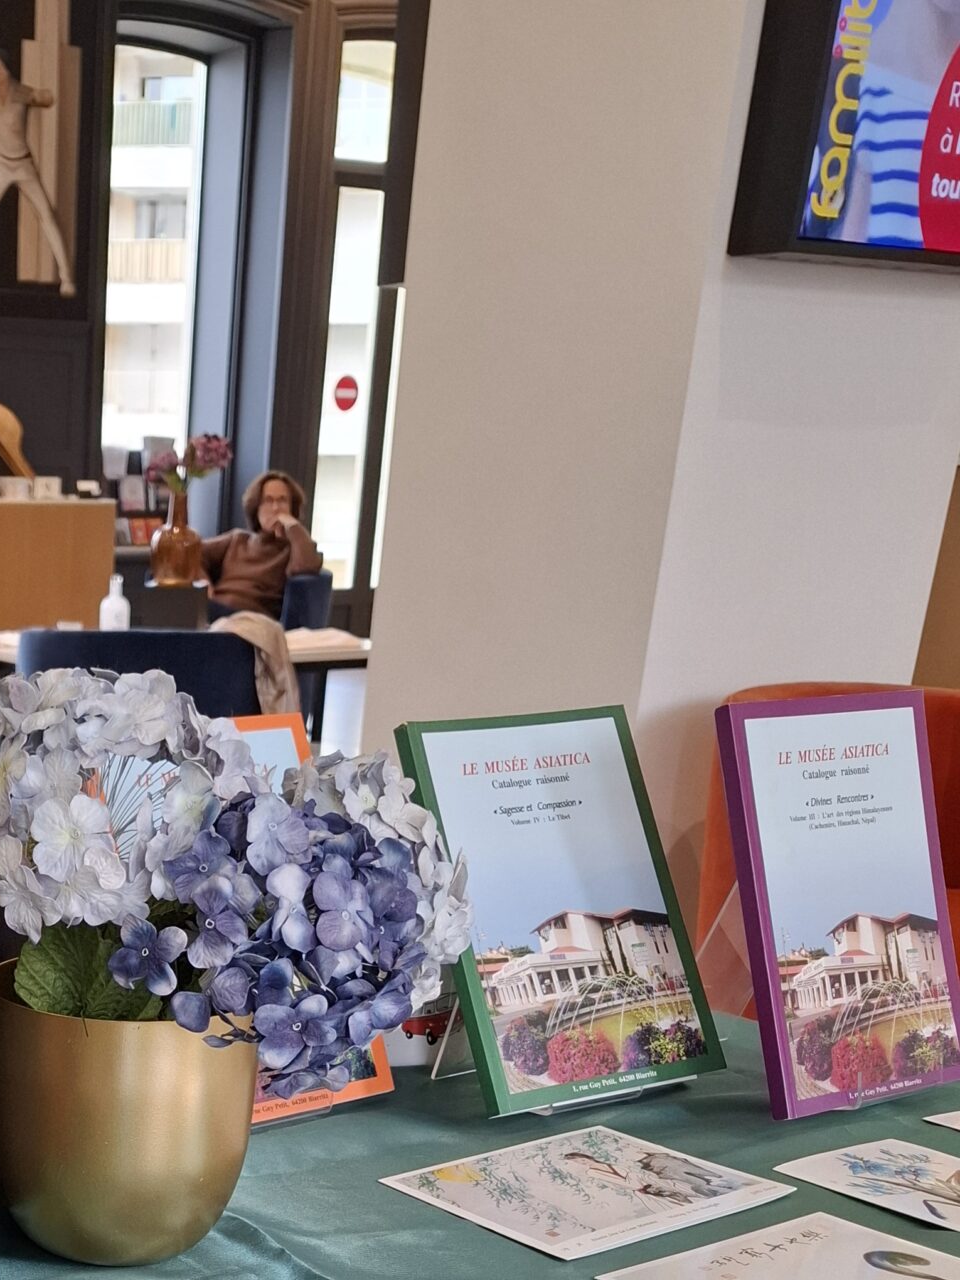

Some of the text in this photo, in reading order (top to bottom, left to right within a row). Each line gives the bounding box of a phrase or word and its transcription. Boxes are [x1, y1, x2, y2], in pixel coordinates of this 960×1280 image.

[778, 742, 889, 765] LE MUSÉE ASIATICA
[462, 751, 591, 776] LE MUSÉE ASIATICA
[802, 764, 870, 781] Catalogue raisonné
[491, 772, 570, 790] Catalogue raisonné
[510, 818, 531, 826] Volume
[556, 813, 571, 821] Tibet
[579, 1084, 589, 1092] rue
[589, 1082, 601, 1090] Guy
[618, 1074, 635, 1084] 64200
[635, 1070, 658, 1080] Biarritz
[865, 1088, 876, 1097] Guy
[904, 1078, 922, 1087] Biarritz
[261, 1105, 274, 1113] Guy
[291, 1097, 307, 1106] 64200
[308, 1093, 329, 1103] Biarritz
